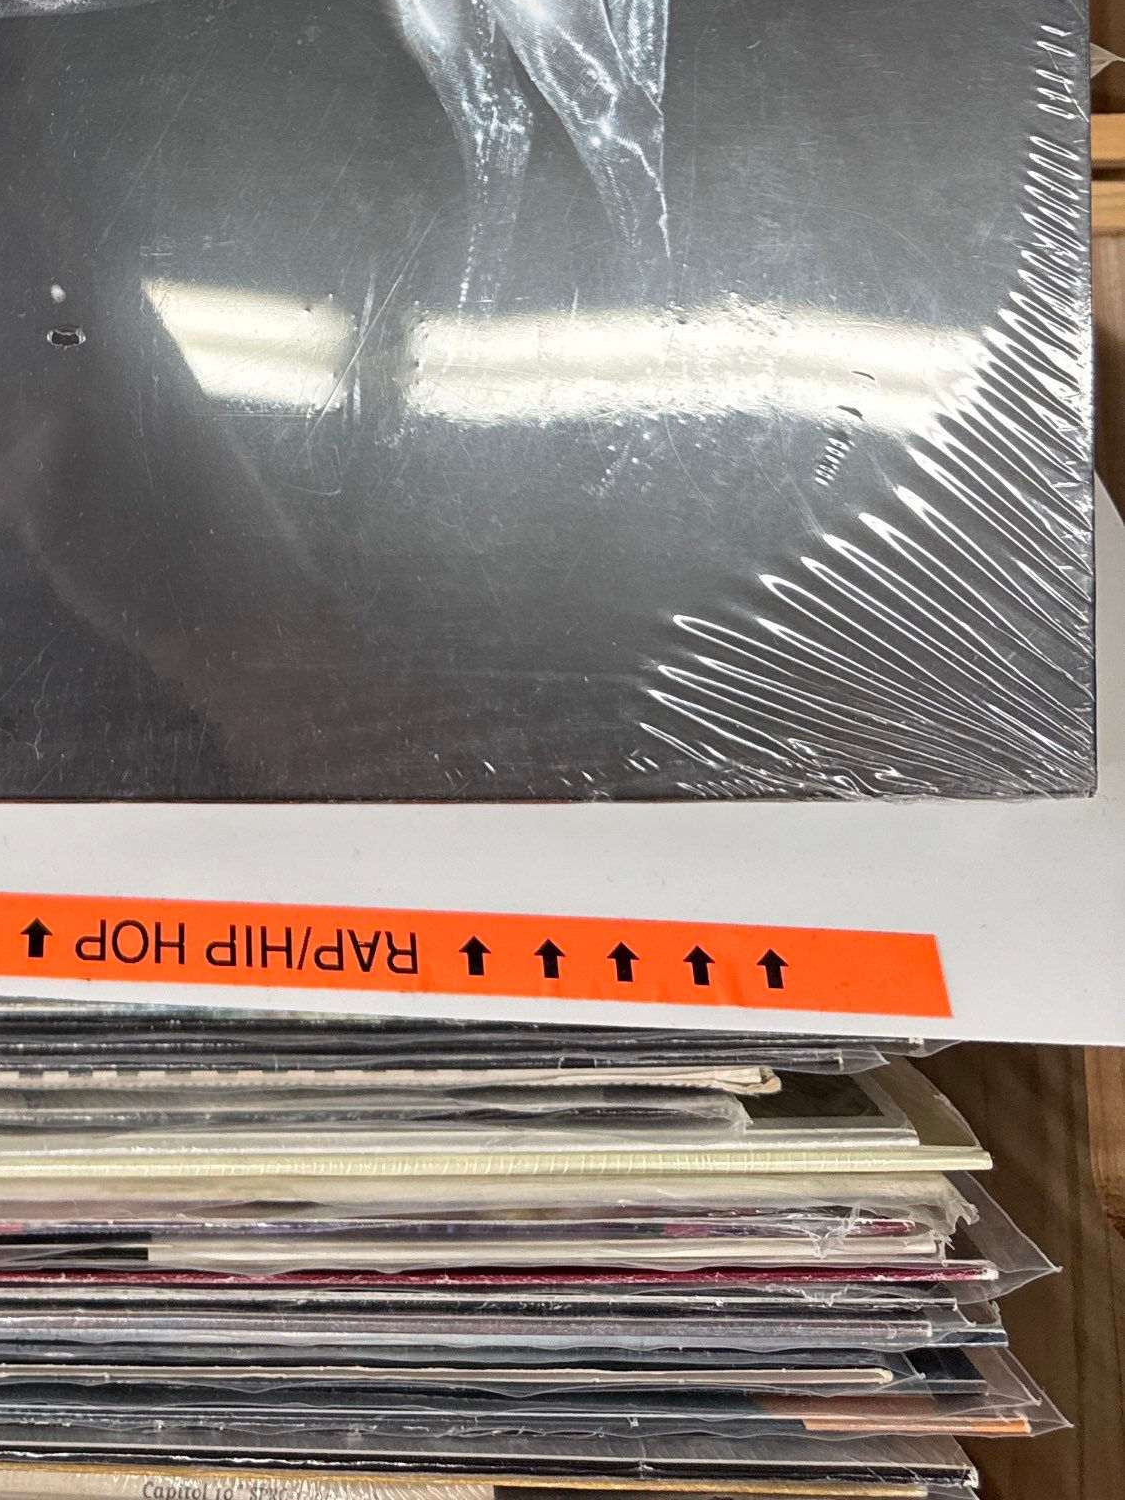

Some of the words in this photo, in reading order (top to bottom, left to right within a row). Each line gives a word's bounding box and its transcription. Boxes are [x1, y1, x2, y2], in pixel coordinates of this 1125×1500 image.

[75, 919, 185, 965] HOP
[205, 924, 418, 975] RAP/HIP
[142, 1481, 208, 1500] Capitol
